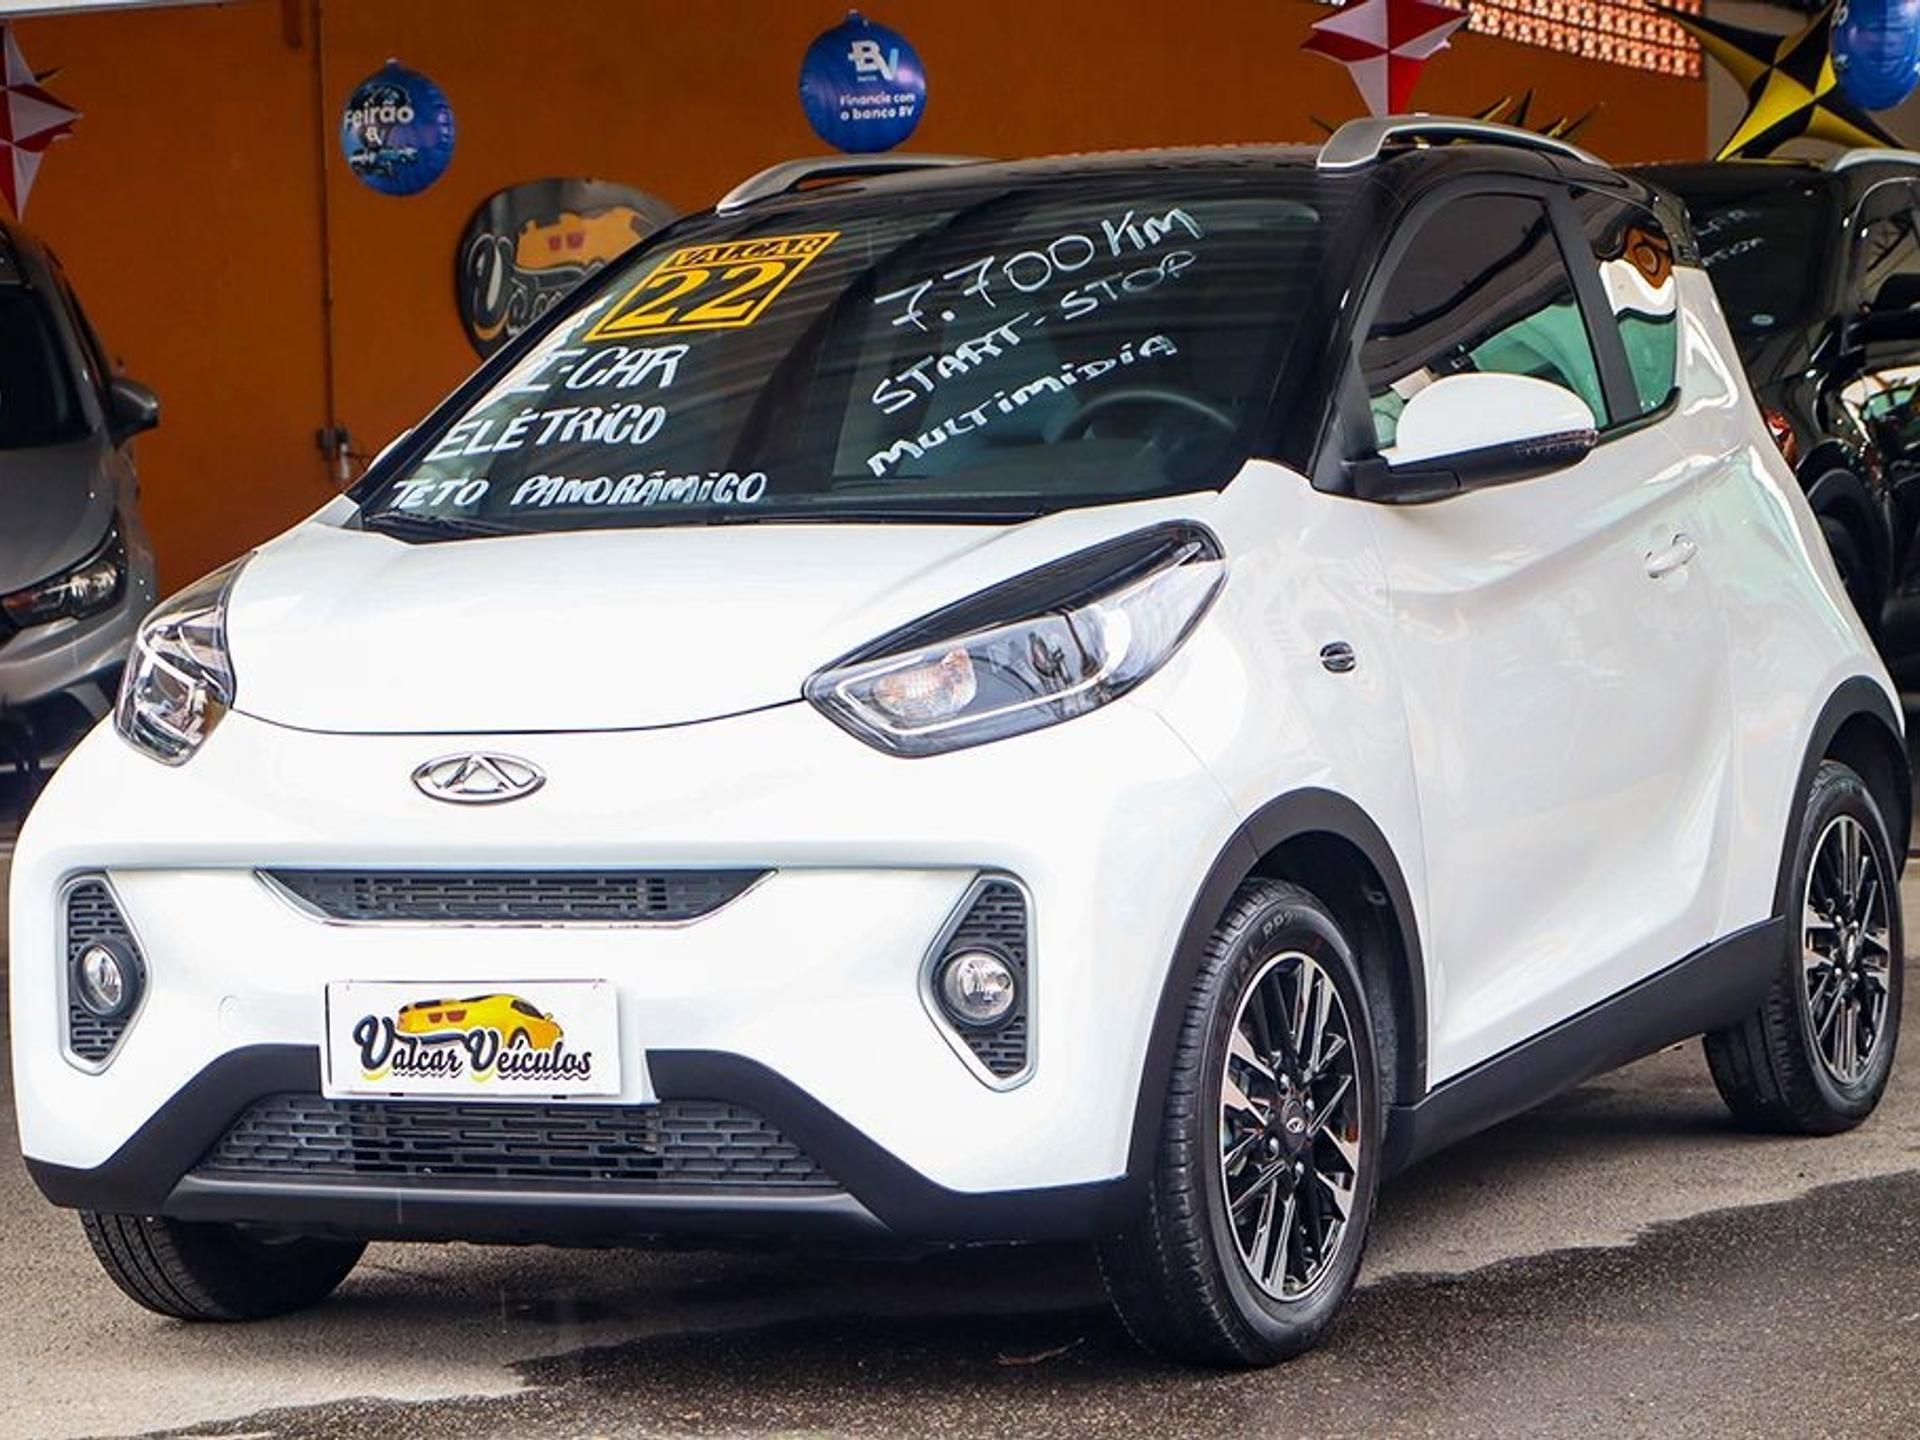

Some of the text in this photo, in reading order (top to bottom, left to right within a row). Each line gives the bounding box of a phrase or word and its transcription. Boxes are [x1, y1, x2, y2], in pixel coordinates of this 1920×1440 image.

[848, 40, 899, 81] BV
[840, 106, 914, 121] o banco BV
[664, 238, 821, 267] VALCAR
[616, 260, 787, 327] 22
[874, 235, 1095, 331] 7.700
[352, 1014, 592, 1075] Valcar Veículos
